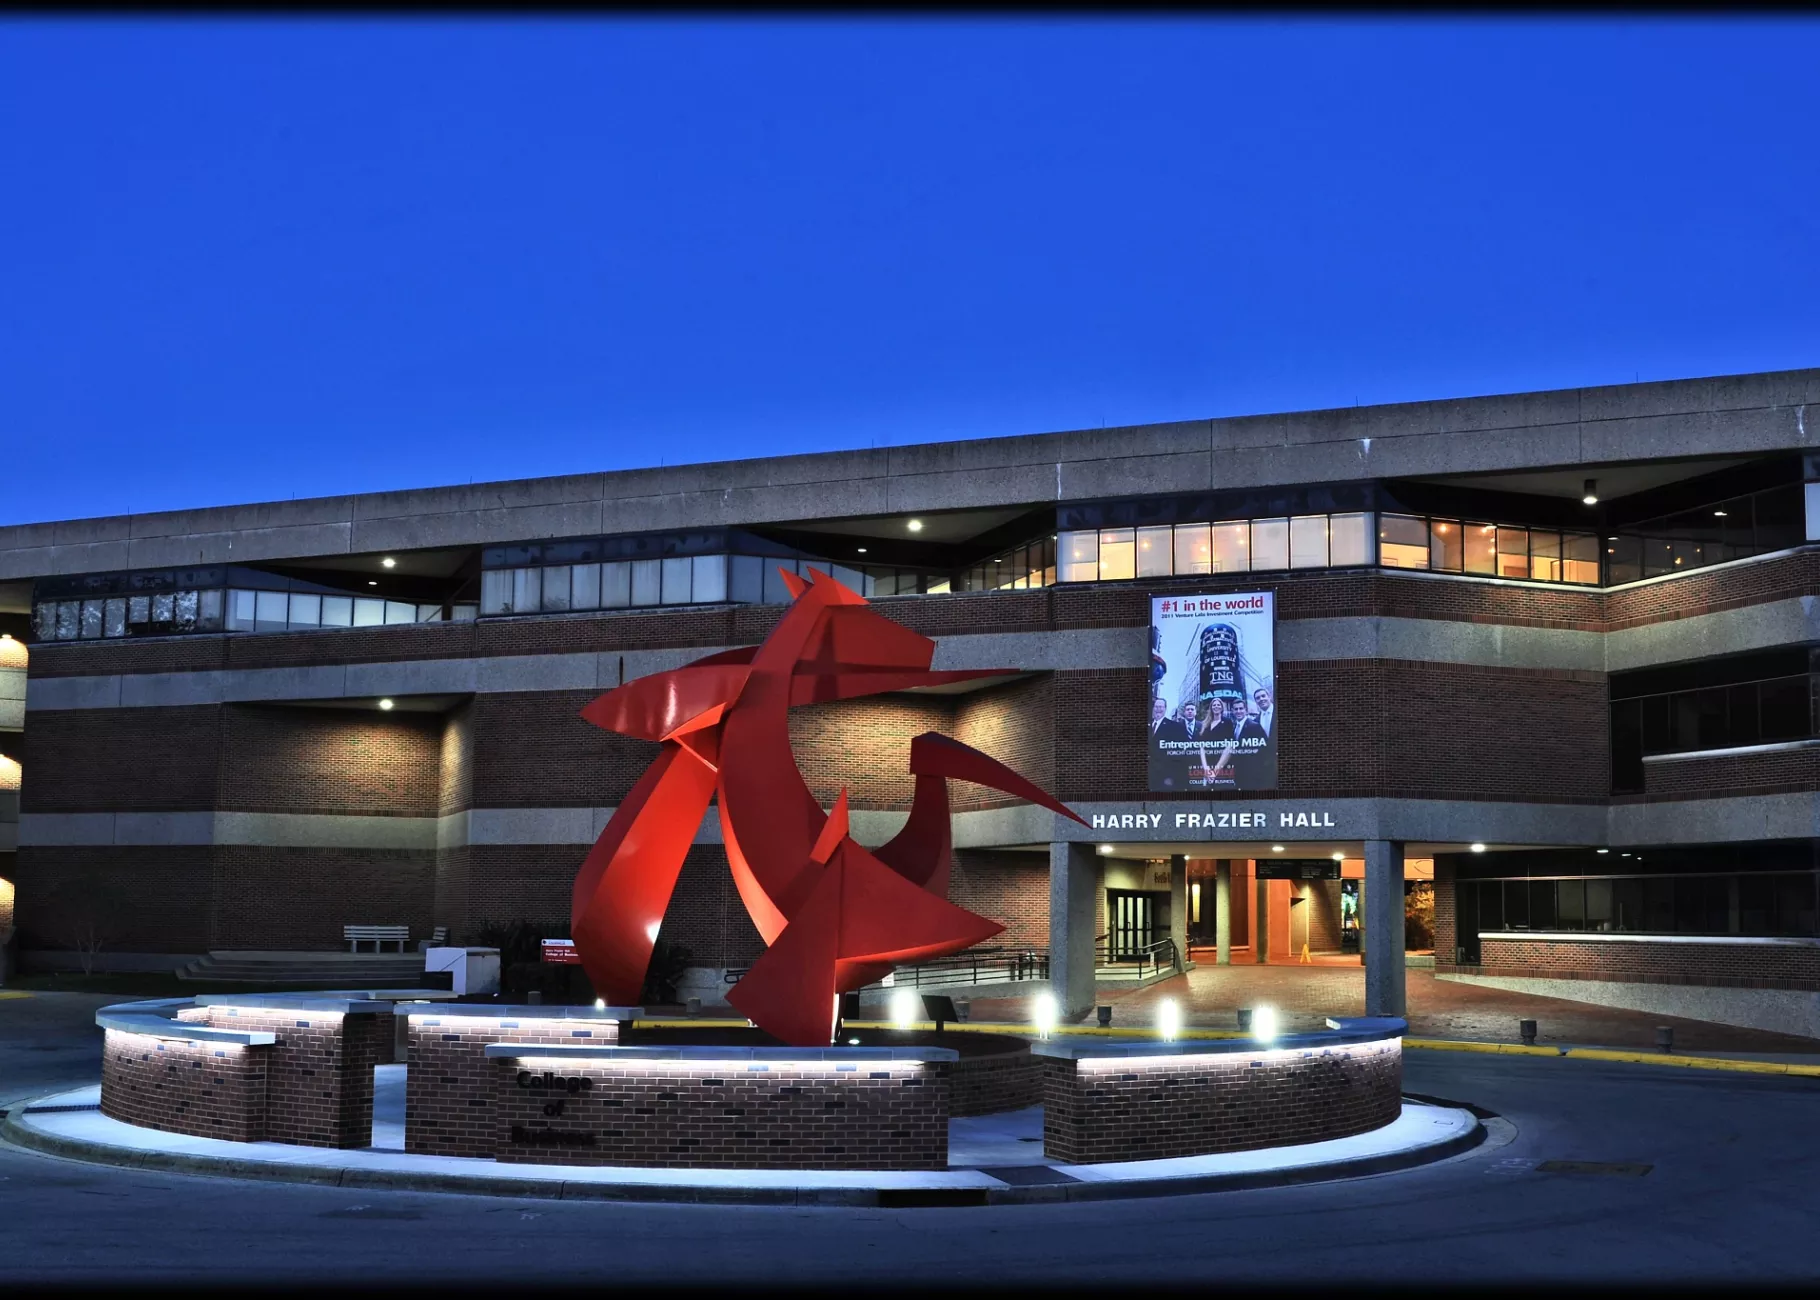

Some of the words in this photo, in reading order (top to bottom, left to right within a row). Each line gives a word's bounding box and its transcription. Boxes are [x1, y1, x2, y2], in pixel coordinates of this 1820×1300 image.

[1161, 600, 1178, 612] #1
[1183, 600, 1196, 611] in
[1200, 599, 1222, 611] the
[1225, 596, 1264, 609] world
[1209, 671, 1234, 681] TNG
[1159, 738, 1240, 750] Entrepreneurship
[1241, 737, 1267, 747] MBA
[1092, 813, 1162, 829] HARRY
[1175, 813, 1267, 828] FRAZIER
[1280, 812, 1335, 827] HALL
[516, 1070, 593, 1094] College
[543, 1099, 565, 1117] of
